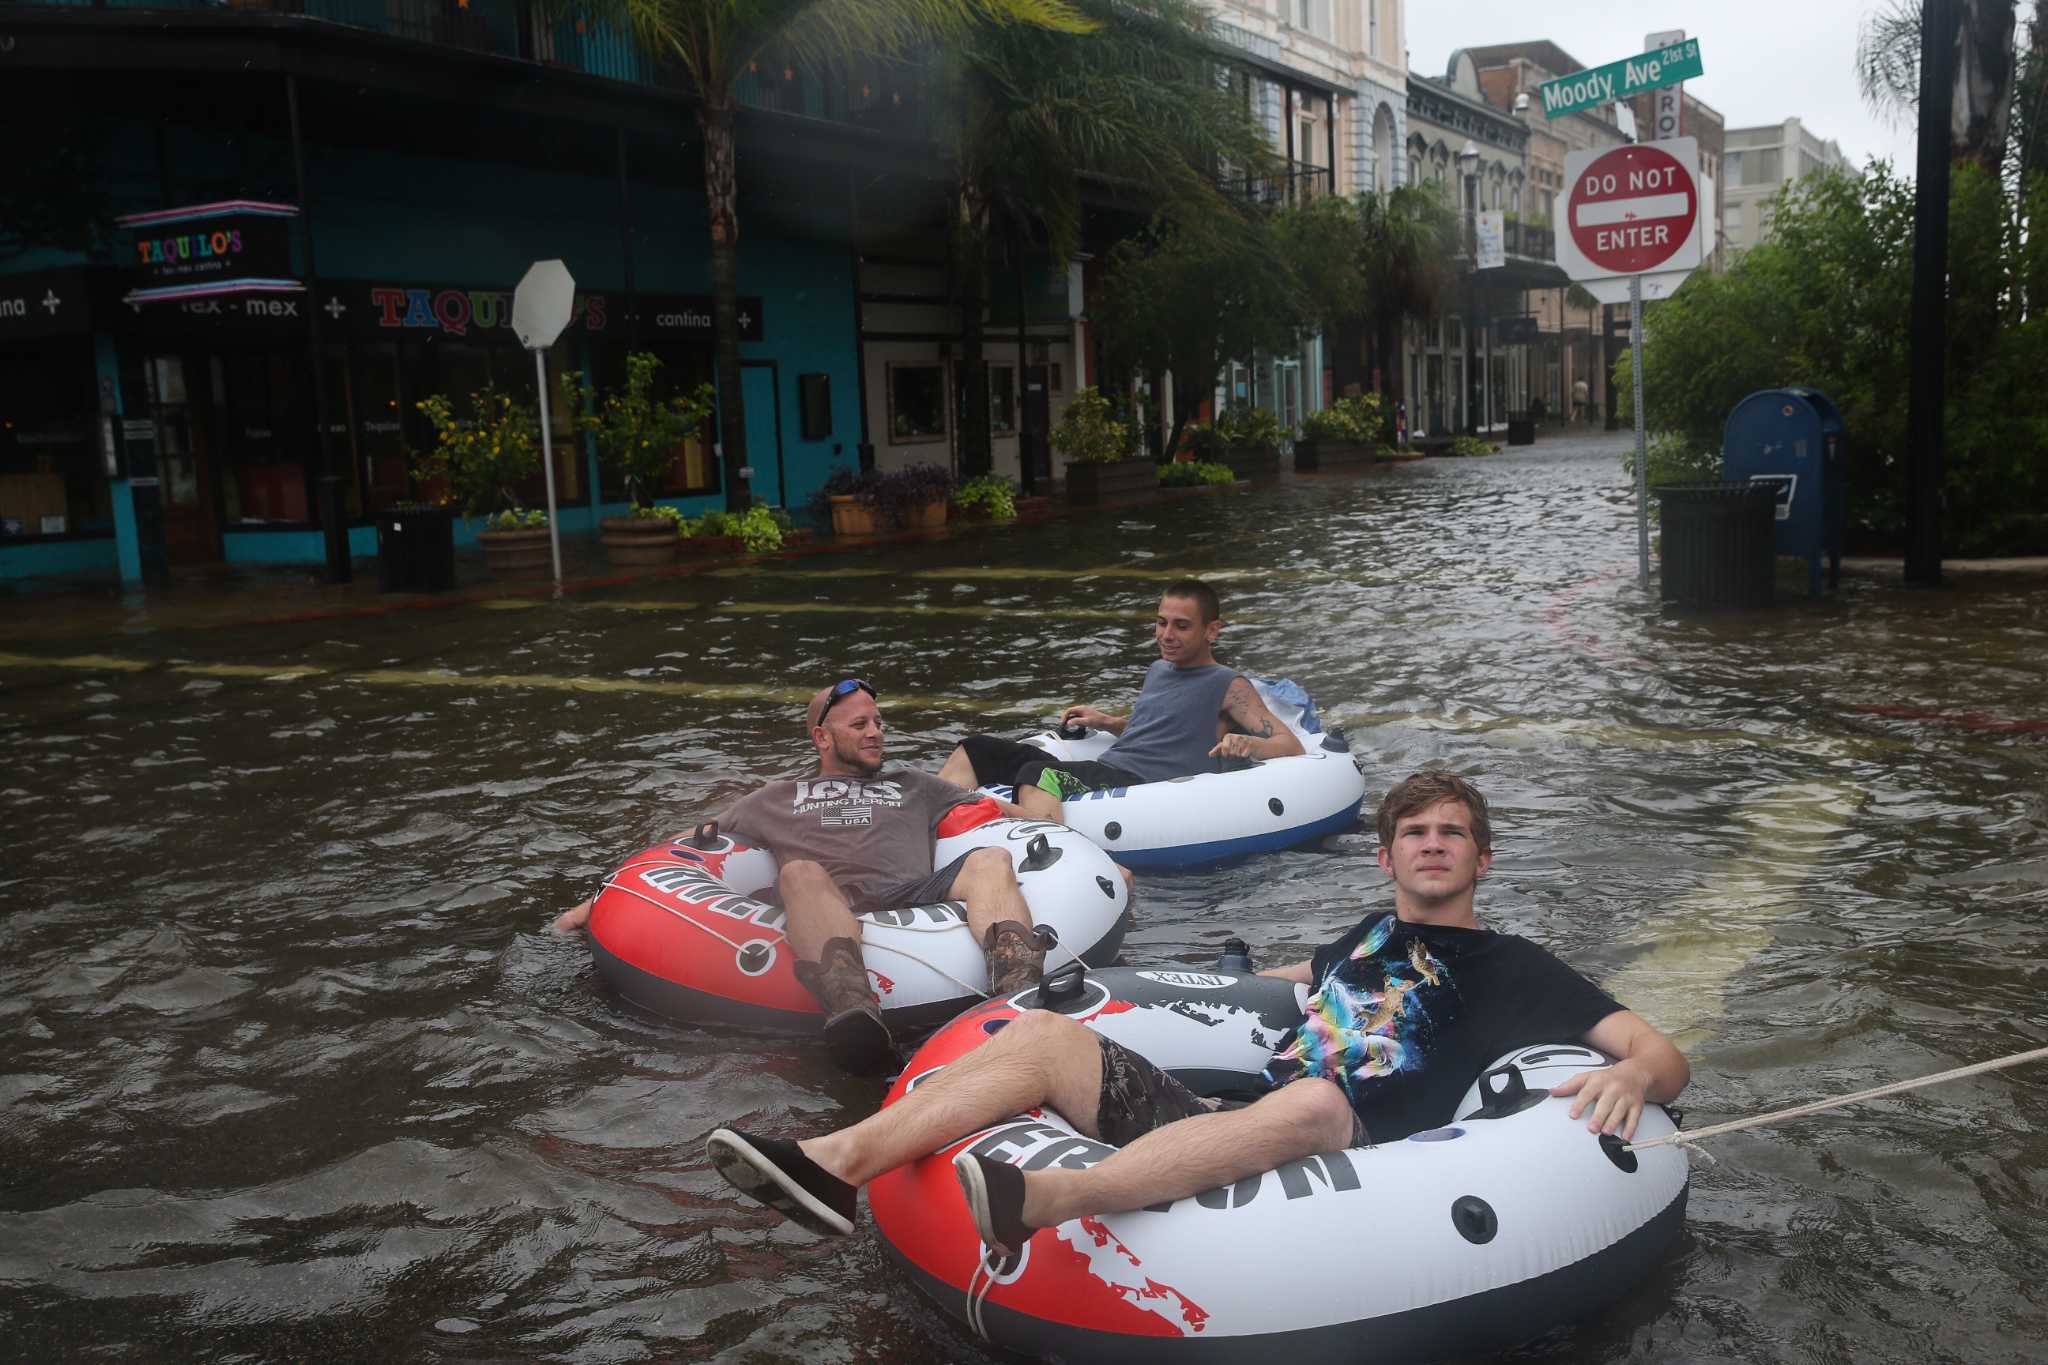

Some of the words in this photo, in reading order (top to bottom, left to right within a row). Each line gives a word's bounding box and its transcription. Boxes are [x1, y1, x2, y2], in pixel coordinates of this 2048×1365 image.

[1543, 72, 1614, 112] Moody
[1624, 59, 1661, 91] Ave
[1662, 47, 1684, 66] 21st
[1686, 43, 1698, 58] St
[1586, 174, 1616, 196] DO
[1629, 167, 1676, 190] NOT
[137, 229, 243, 264] TAQUILO'S
[1596, 225, 1669, 252] ENTER
[246, 298, 298, 317] mex
[655, 309, 712, 328] cantina
[793, 798, 849, 815] HUNTING
[853, 798, 904, 808] PERMIT
[1153, 971, 1226, 986] INTEX
